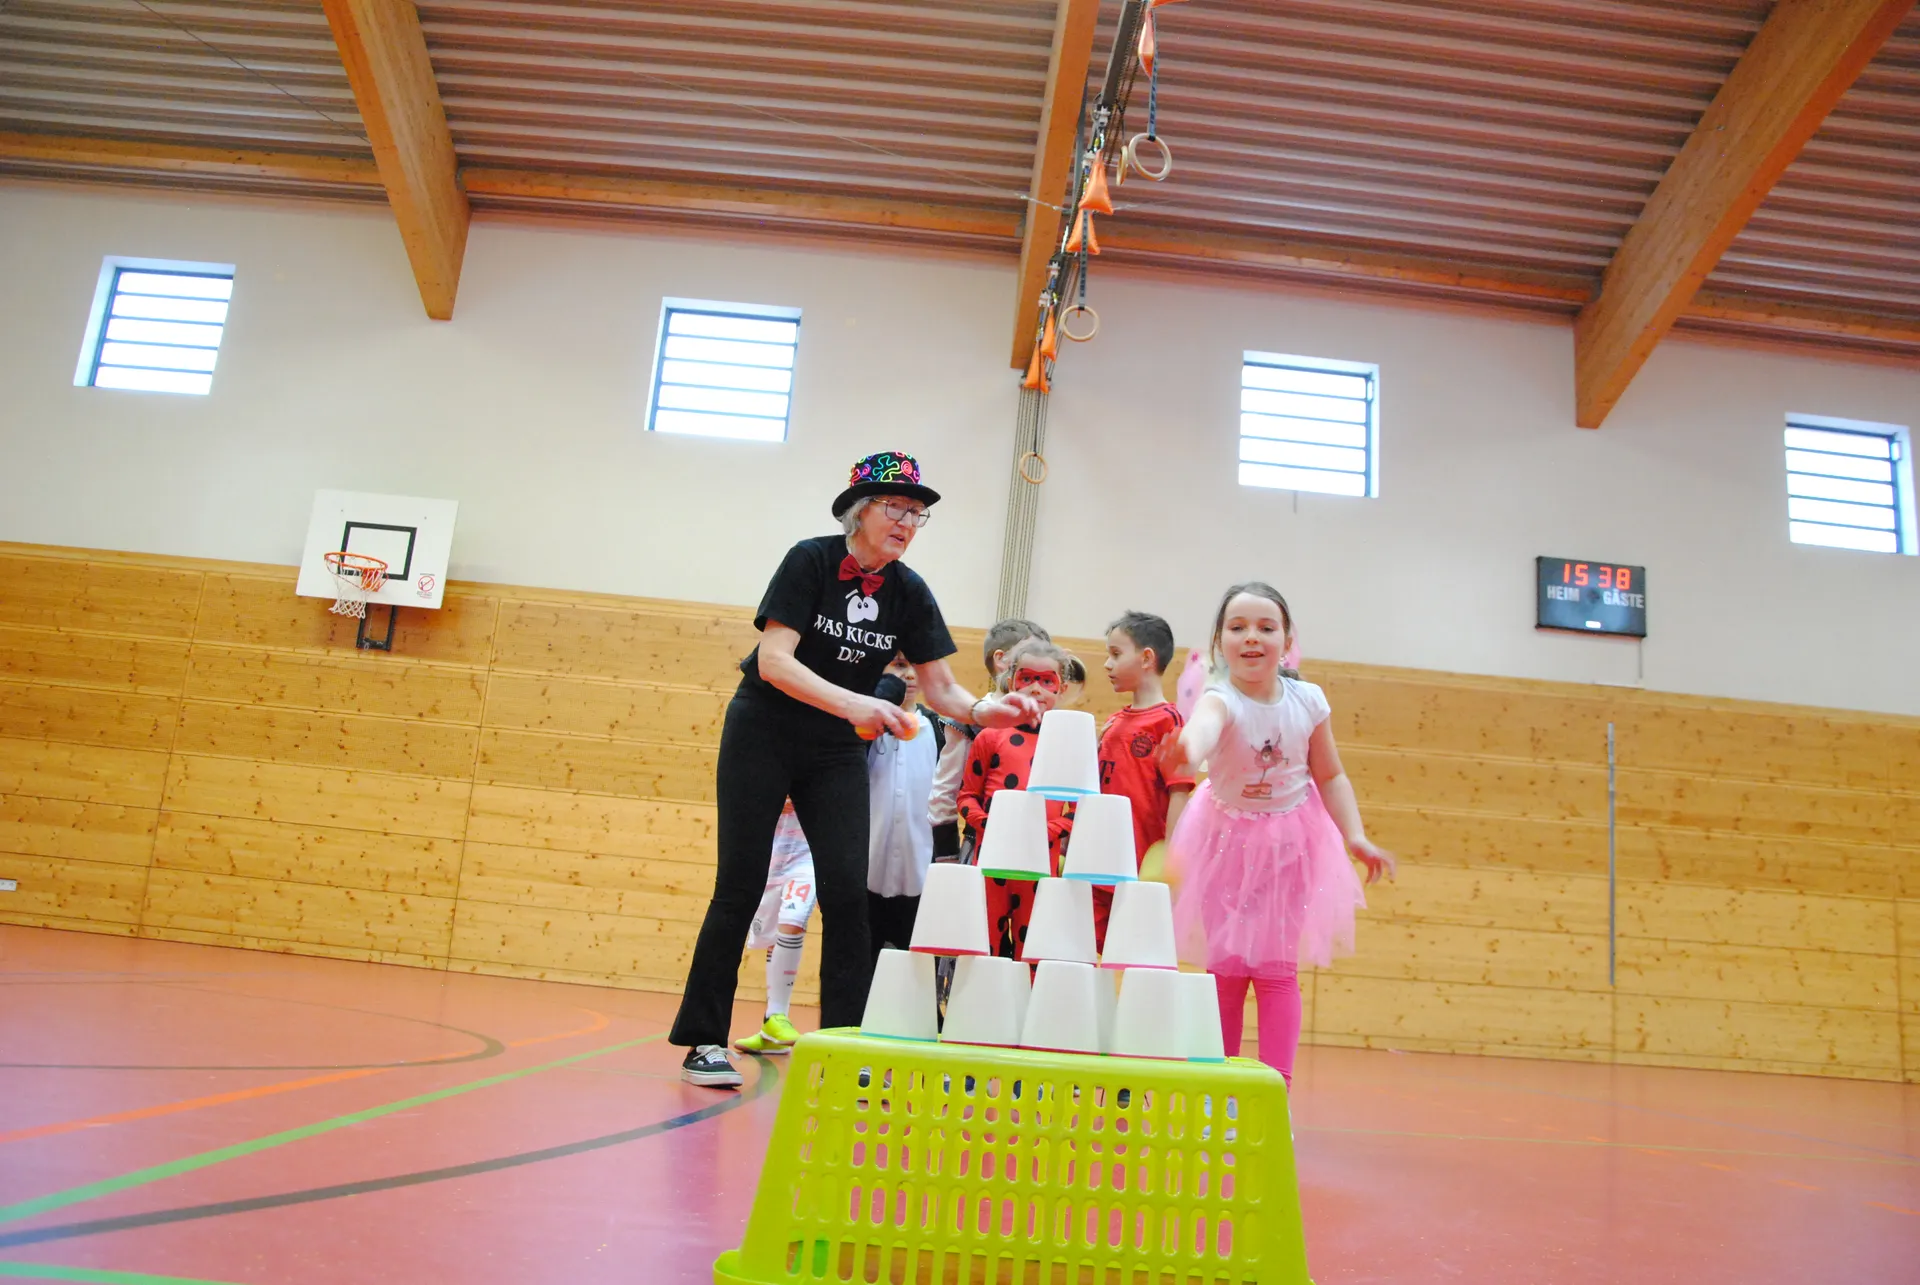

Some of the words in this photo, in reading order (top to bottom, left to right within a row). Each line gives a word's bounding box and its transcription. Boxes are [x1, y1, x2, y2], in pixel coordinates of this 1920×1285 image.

[1563, 563, 1589, 586] 15
[1598, 566, 1630, 590] 38
[1547, 585, 1579, 601] HEIM
[1603, 589, 1644, 608] GÄSTE
[813, 614, 843, 637] WAS
